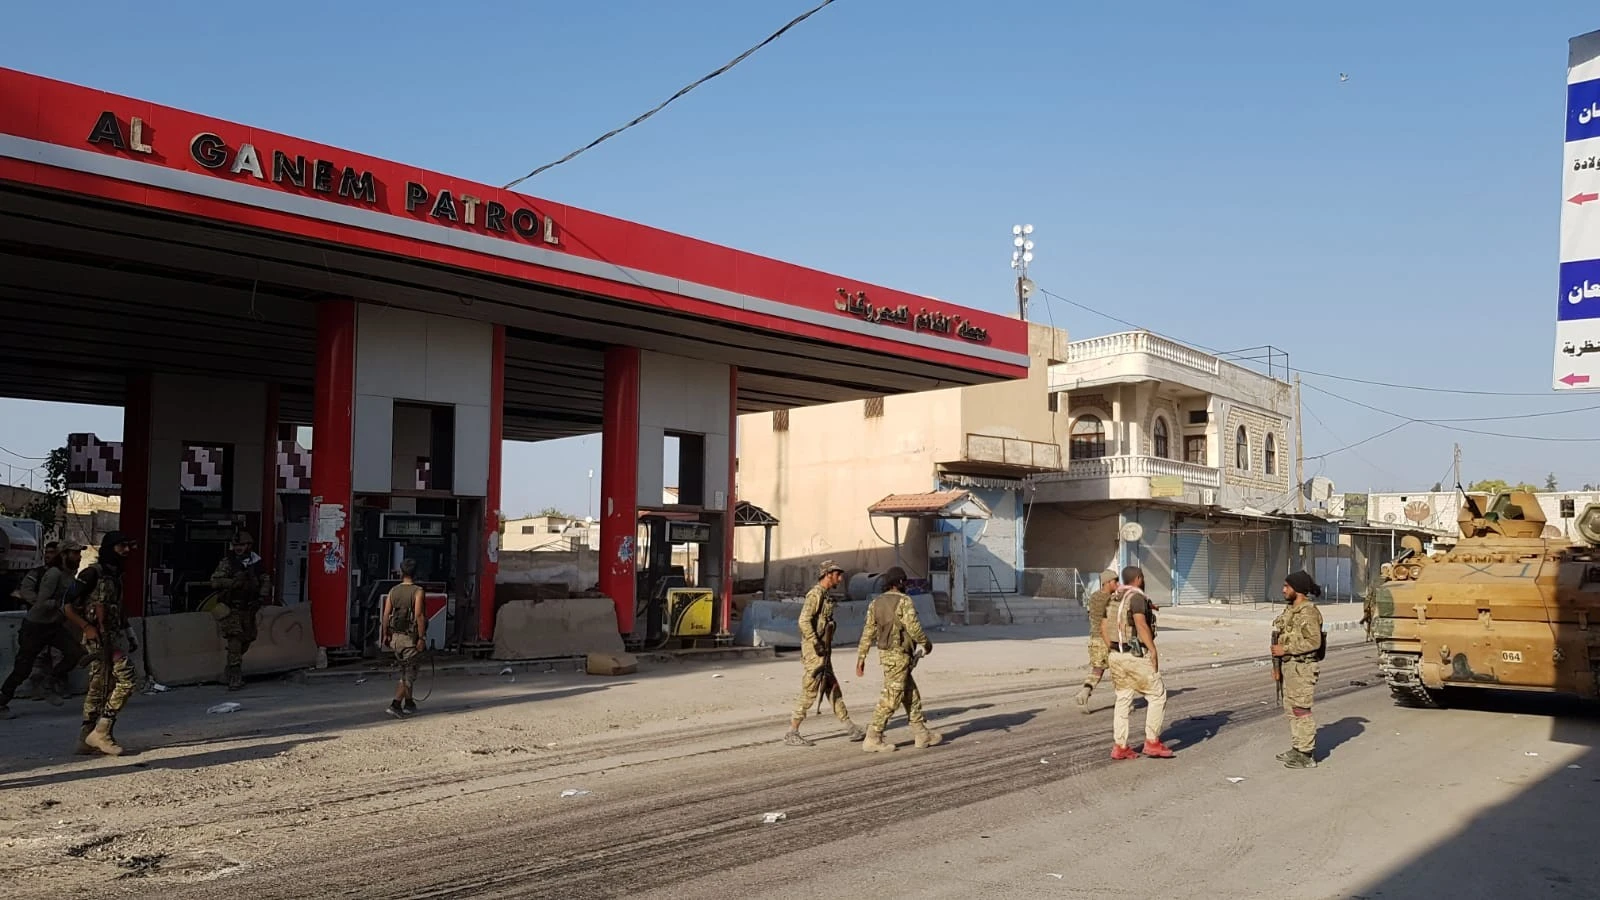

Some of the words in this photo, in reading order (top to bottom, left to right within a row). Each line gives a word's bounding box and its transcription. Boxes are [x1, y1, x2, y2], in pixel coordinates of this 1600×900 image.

[87, 110, 153, 155] AL
[189, 131, 377, 203] GANEM
[405, 181, 561, 245] PATROL
[1502, 652, 1521, 662] 064
